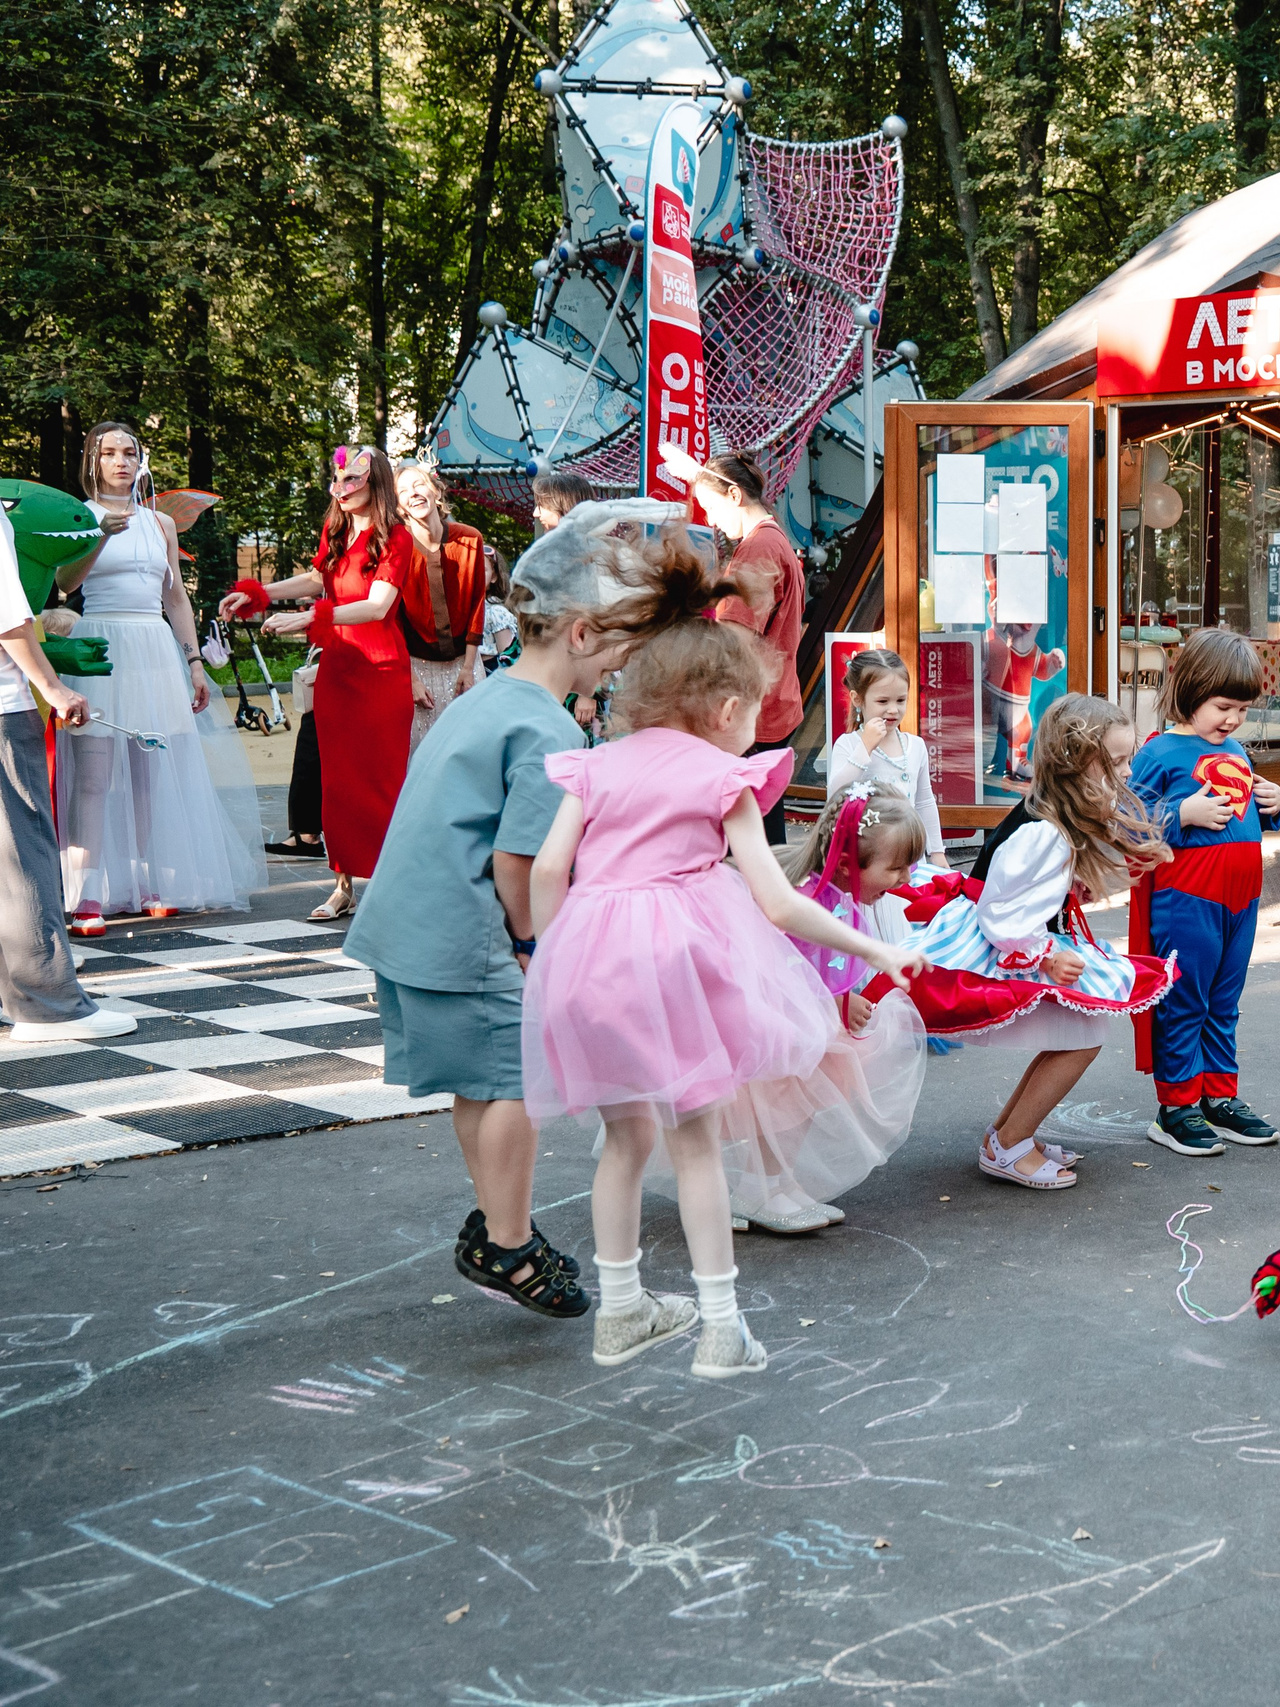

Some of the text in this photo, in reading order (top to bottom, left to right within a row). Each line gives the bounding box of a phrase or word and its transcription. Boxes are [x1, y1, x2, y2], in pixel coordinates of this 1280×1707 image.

[1186, 360, 1205, 385] В
[928, 651, 937, 688] ЛЕТО
[928, 699, 937, 737] ЛЕТО
